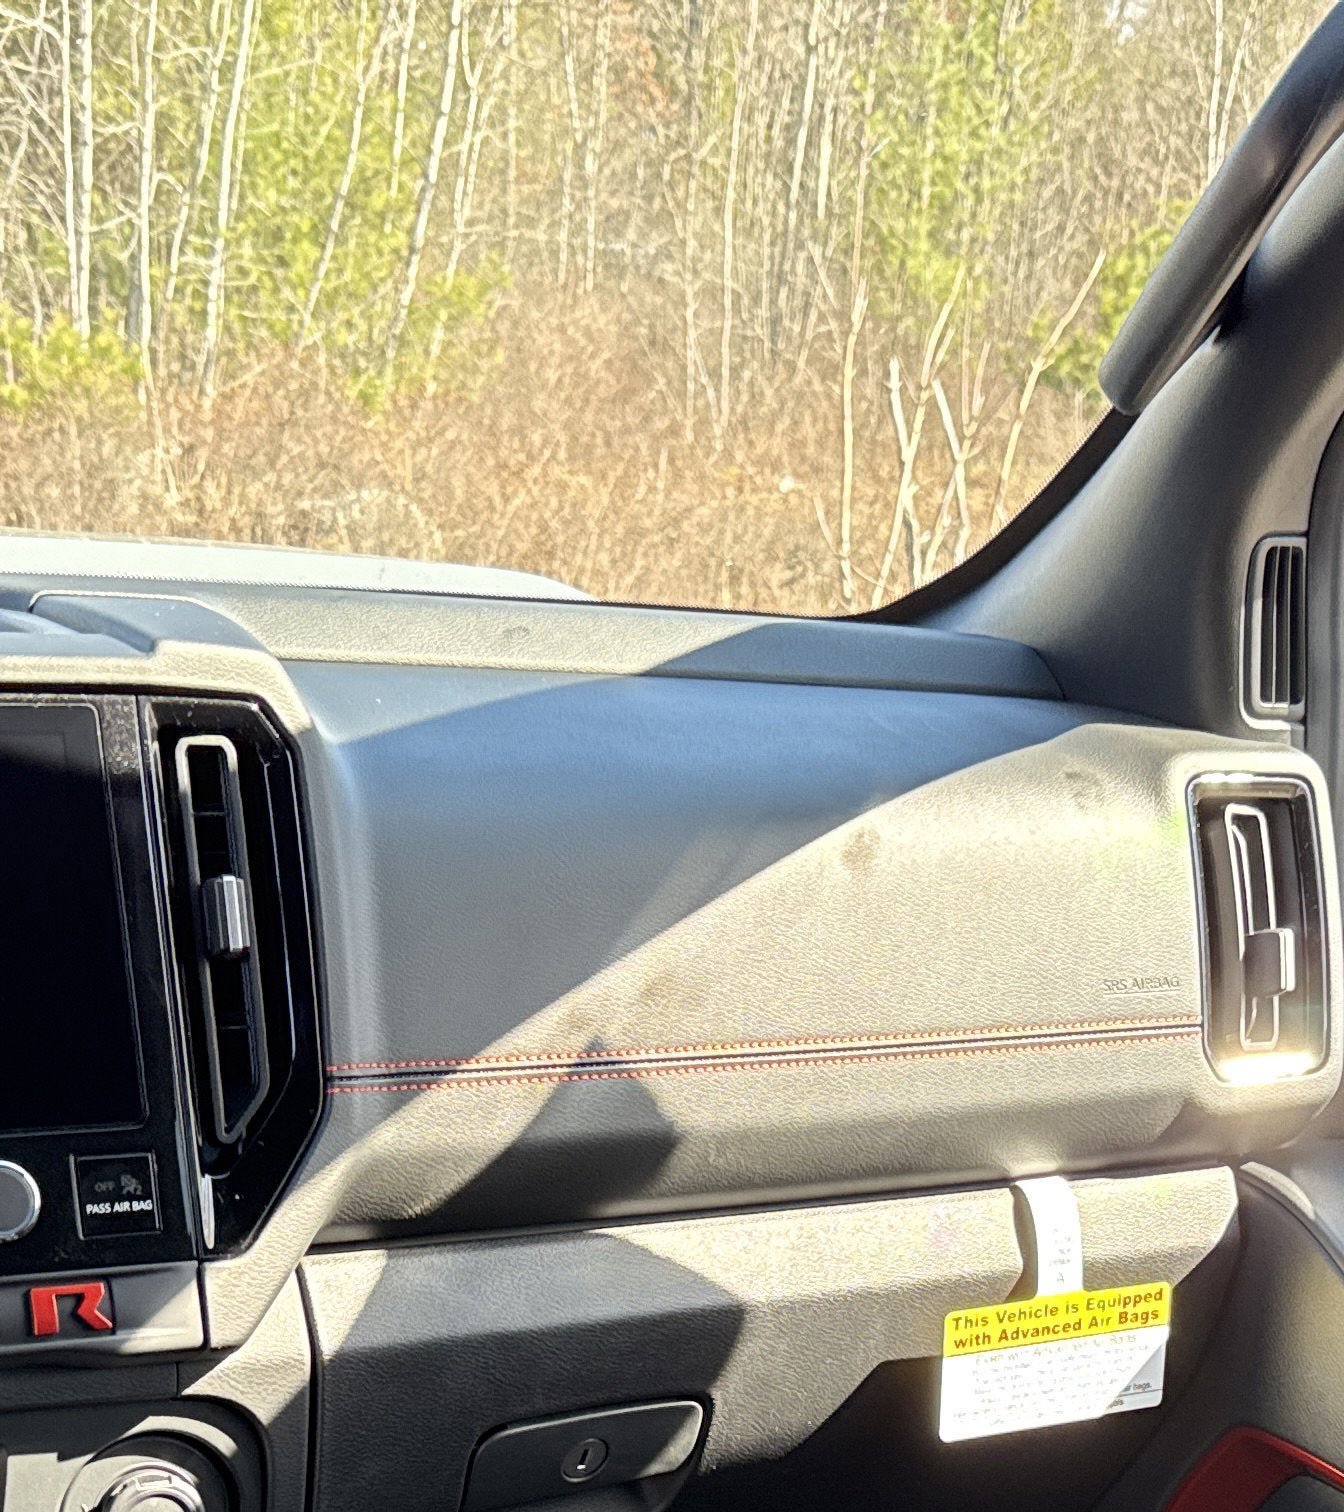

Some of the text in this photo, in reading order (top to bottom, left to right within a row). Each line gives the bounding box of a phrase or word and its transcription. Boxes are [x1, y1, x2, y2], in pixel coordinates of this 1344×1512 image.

[1132, 976, 1181, 990] AIRBAG
[85, 1199, 153, 1215] PASS AIR BAG
[952, 1287, 1163, 1332] This Vehicle is Equipped
[954, 1308, 1160, 1349] with Advanced Air Bags
